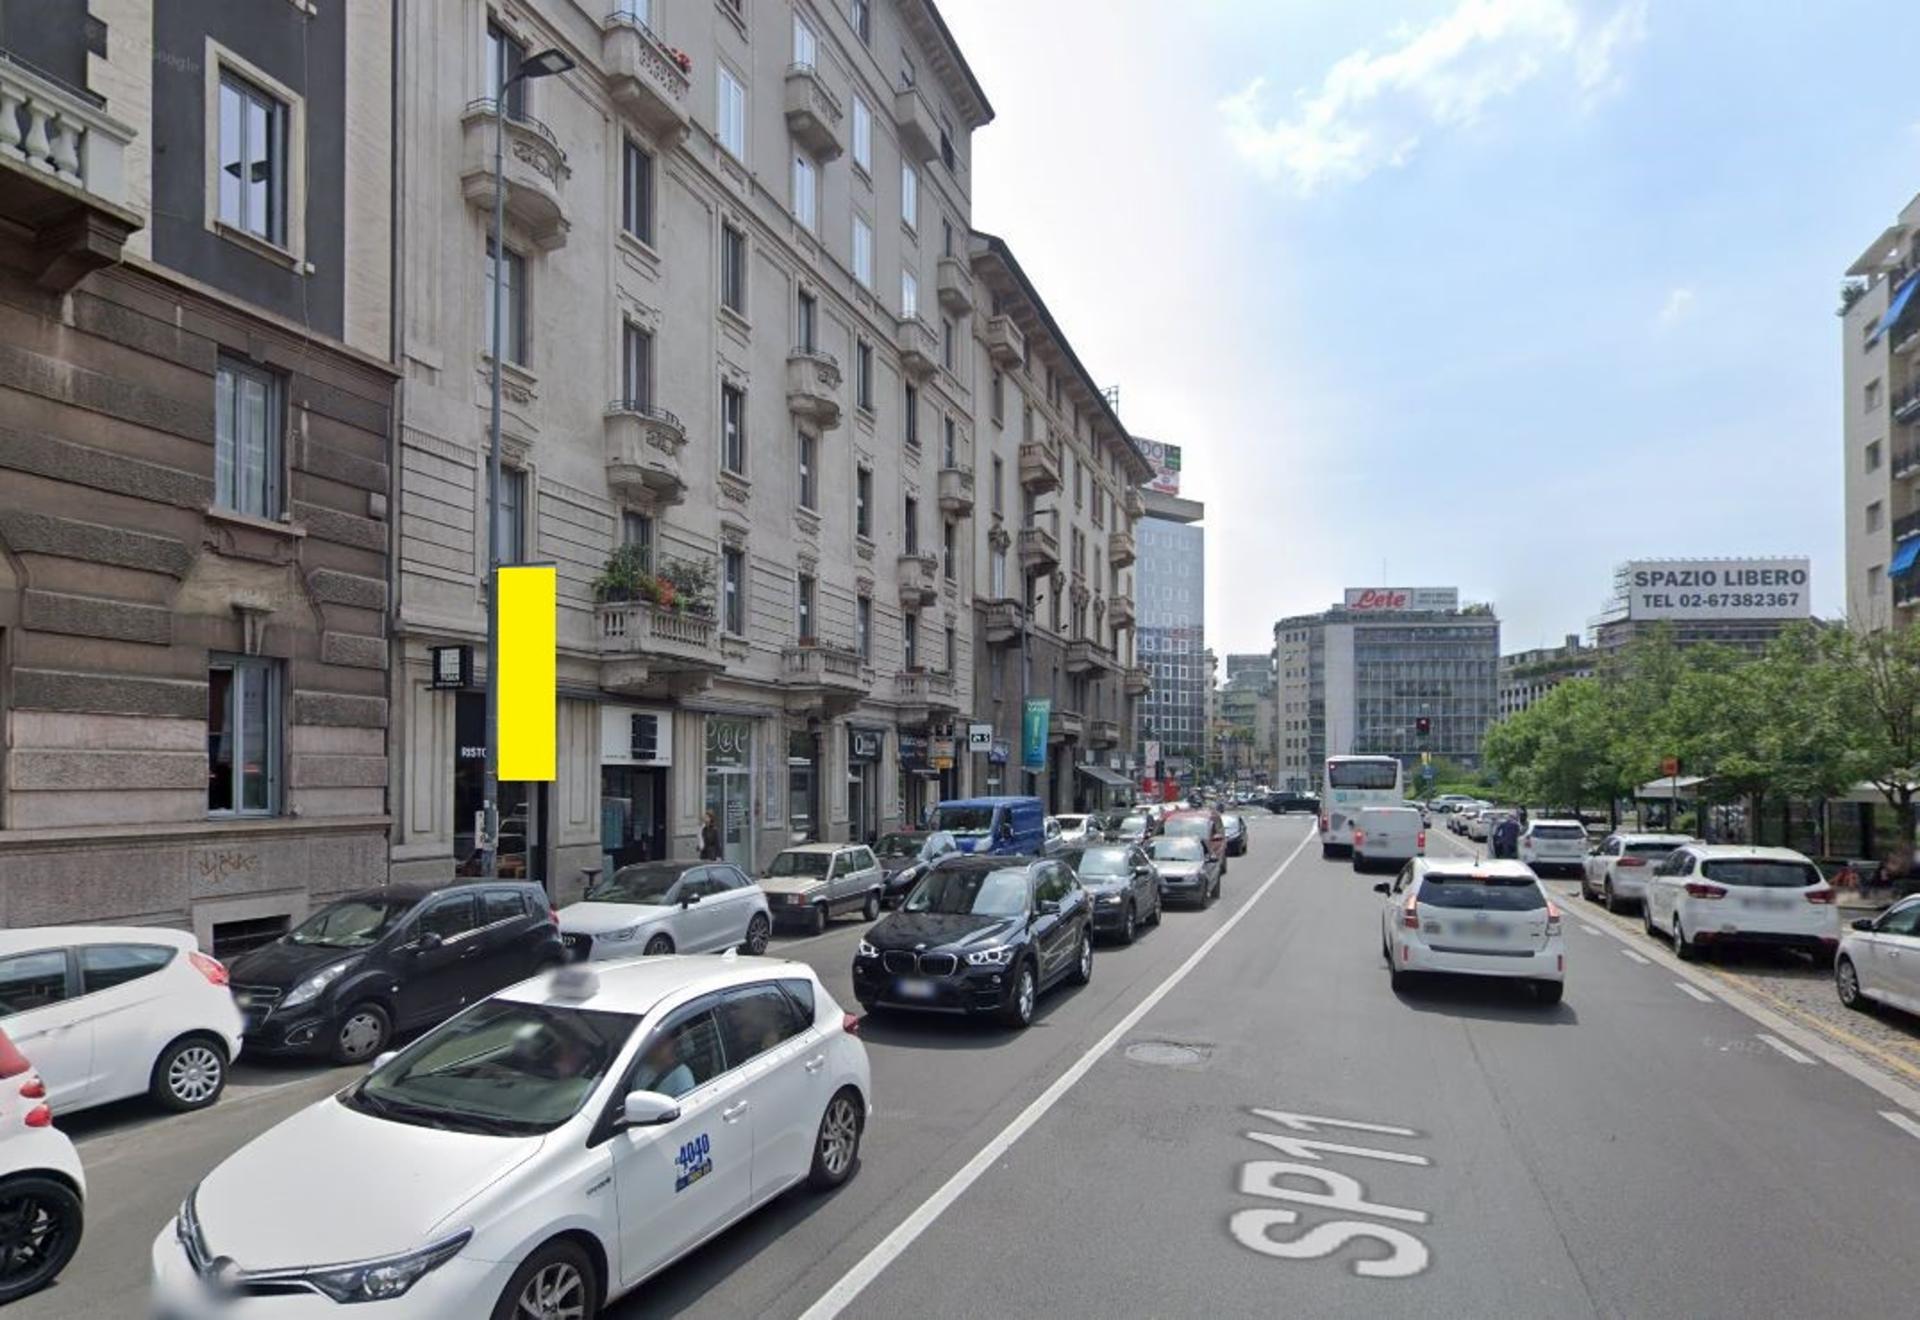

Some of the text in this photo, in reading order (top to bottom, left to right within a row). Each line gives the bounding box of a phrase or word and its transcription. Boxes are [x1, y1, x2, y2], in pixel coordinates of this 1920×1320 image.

[1635, 569, 1807, 587] SPAZIO LIBERO
[1352, 589, 1406, 609] Lete
[1643, 593, 1799, 608] TEL 02-67382367
[679, 1133, 710, 1170] 4040
[1230, 1108, 1430, 1278] SP11
